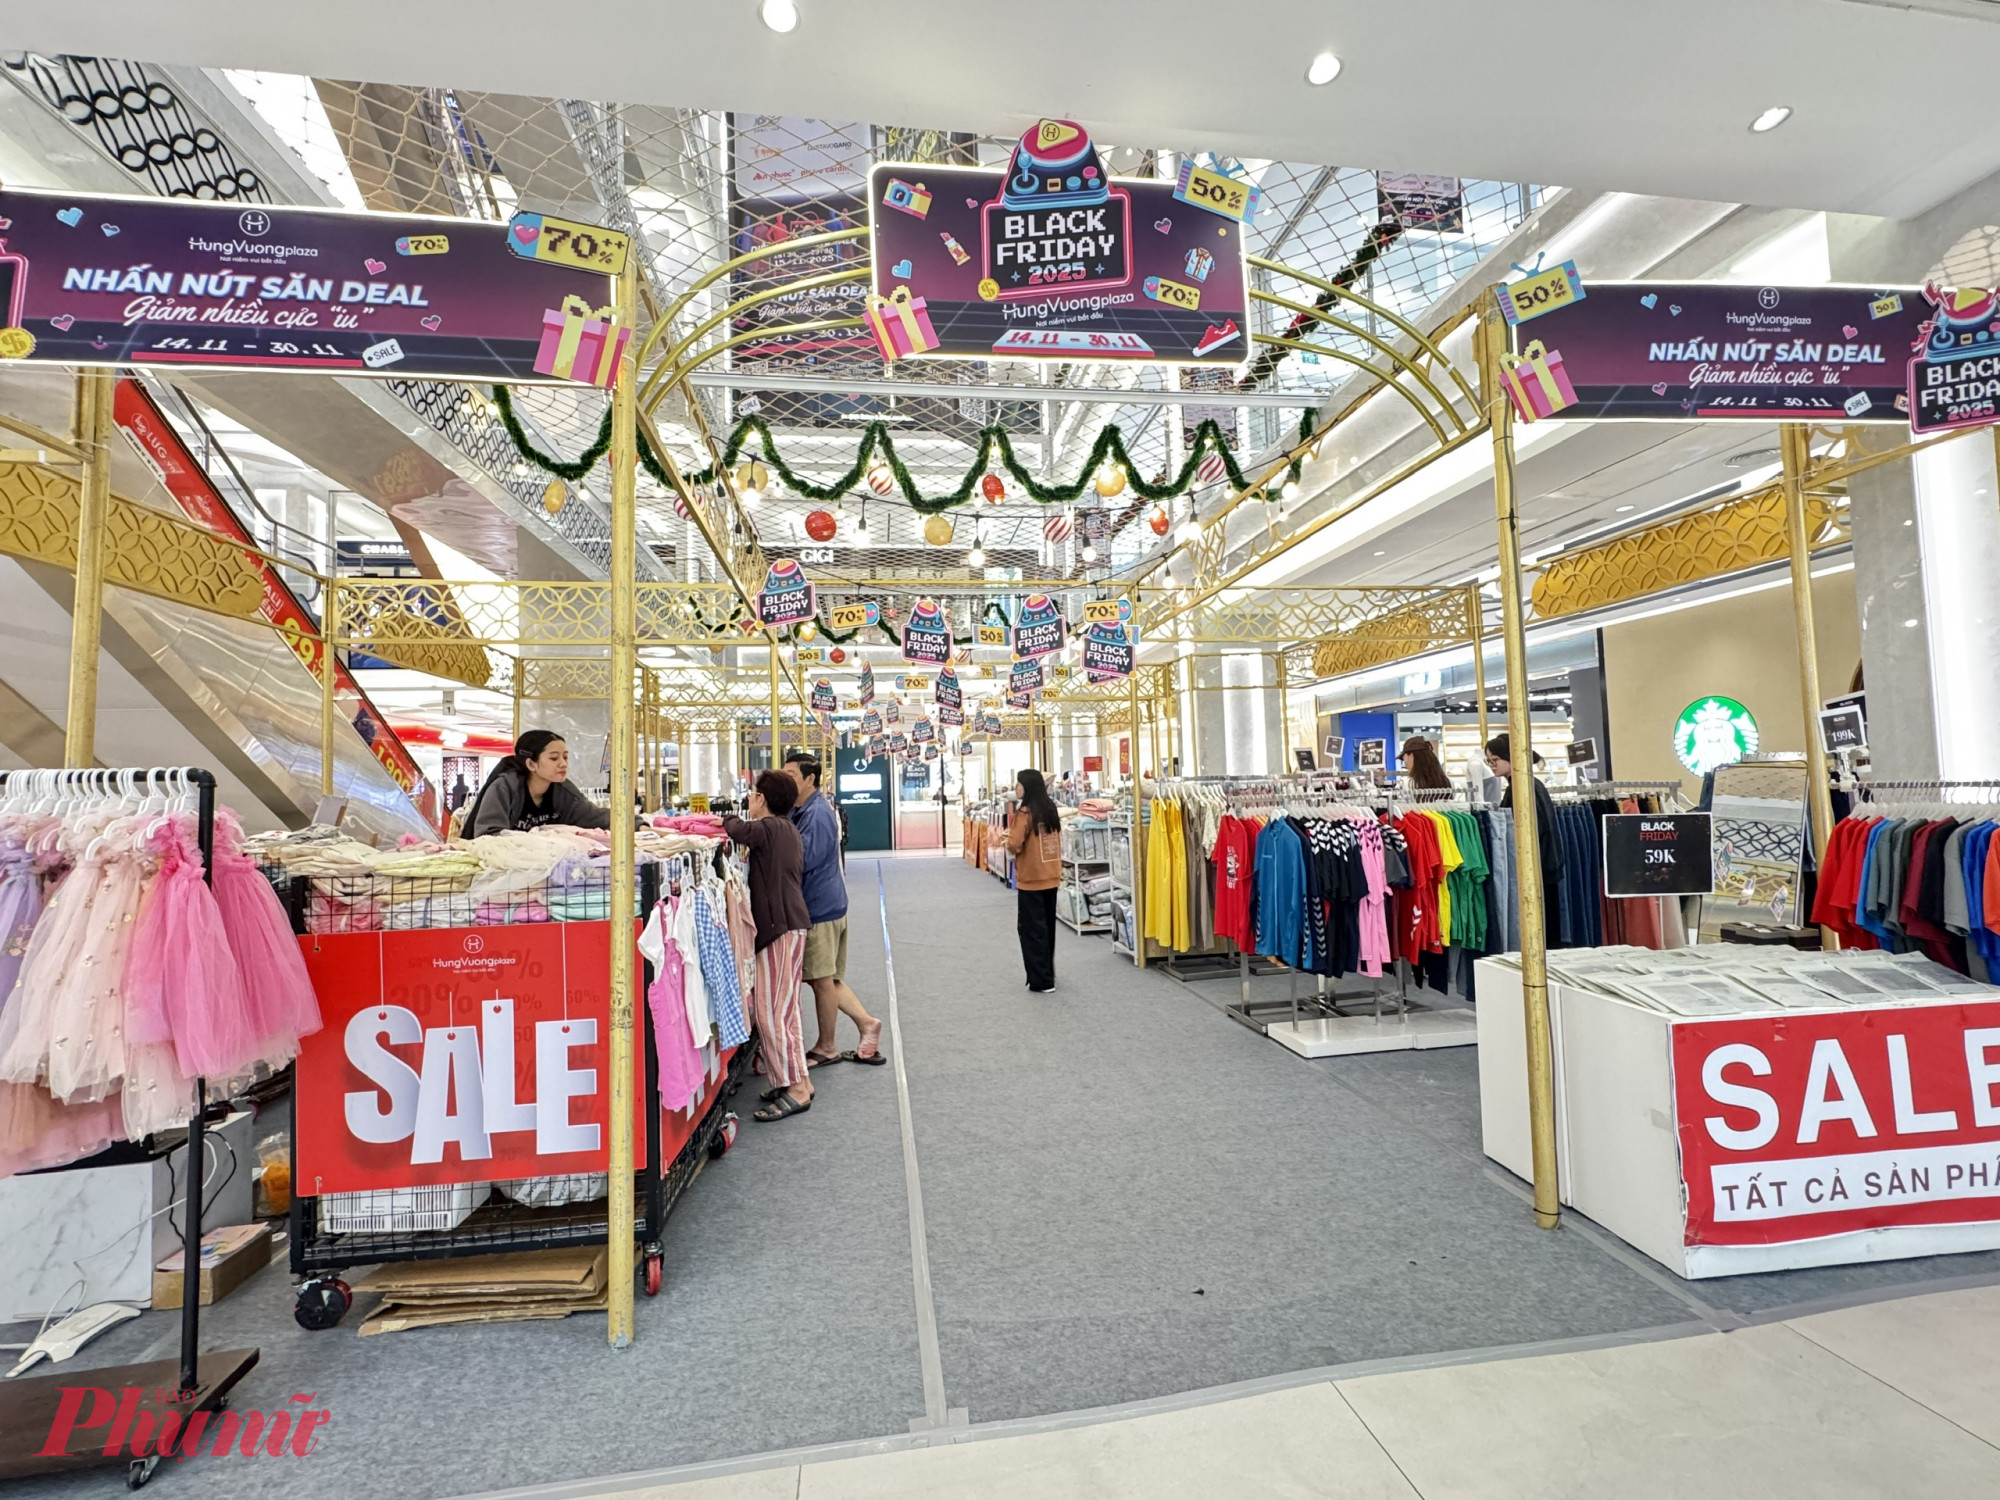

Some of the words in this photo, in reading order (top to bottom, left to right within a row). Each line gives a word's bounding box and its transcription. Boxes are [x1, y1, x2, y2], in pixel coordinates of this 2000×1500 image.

[1004, 208, 1106, 239] BLACK
[188, 236, 318, 259] HungVuongplaza
[996, 234, 1115, 265] FRIDAY
[1028, 261, 1086, 285] 2025
[62, 264, 174, 294] NHẤN
[179, 269, 256, 298] NÚT
[259, 271, 334, 301] SĂN
[339, 280, 429, 307] DEAL
[123, 295, 197, 327] Giảm
[200, 298, 270, 325] nhiều
[1002, 293, 1135, 321] HungVuongplaza
[152, 337, 228, 351] 14.11
[269, 341, 345, 357] 30.11
[1006, 331, 1060, 345] 14.11
[1089, 334, 1143, 349] 30.11
[1648, 335, 1719, 362] NHẤN
[1722, 338, 1772, 363] NÚT
[1774, 339, 1822, 363] SĂN
[1826, 344, 1886, 363] DEAL
[372, 343, 399, 361] SALE
[1689, 362, 1736, 390] Giảm
[1738, 362, 1782, 384] nhiều
[1709, 396, 1758, 406] 14.11
[1783, 397, 1833, 407] 30.11
[1921, 379, 2000, 408] FRIDA
[1947, 400, 1996, 421] 2025
[146, 432, 168, 459] LUG
[360, 544, 410, 555] CHARL
[800, 549, 834, 563] GIGI
[765, 590, 805, 606] BLACK
[762, 599, 809, 616] FRIDAY
[910, 631, 945, 645] BLACK
[1017, 631, 1060, 649] FRIDAY
[1020, 623, 1056, 640] BLACK
[906, 641, 947, 654] FRIDAY
[1090, 642, 1127, 657] BLACK
[1086, 651, 1130, 666] FRIDAY
[1011, 676, 1041, 688] FRIDAY
[1013, 669, 1039, 680] BLACK
[937, 690, 961, 704] FRIDAY
[939, 684, 959, 697] BLACK
[1641, 821, 1675, 832] BLACK
[1640, 831, 1679, 841] FRIDAY
[1645, 849, 1676, 864] 59K
[343, 998, 601, 1166] SALE
[1701, 1026, 2000, 1151] SALE
[1721, 1172, 1788, 1212] TẤT
[1804, 1167, 1850, 1204] CẢ
[1863, 1161, 1931, 1198] SẢN
